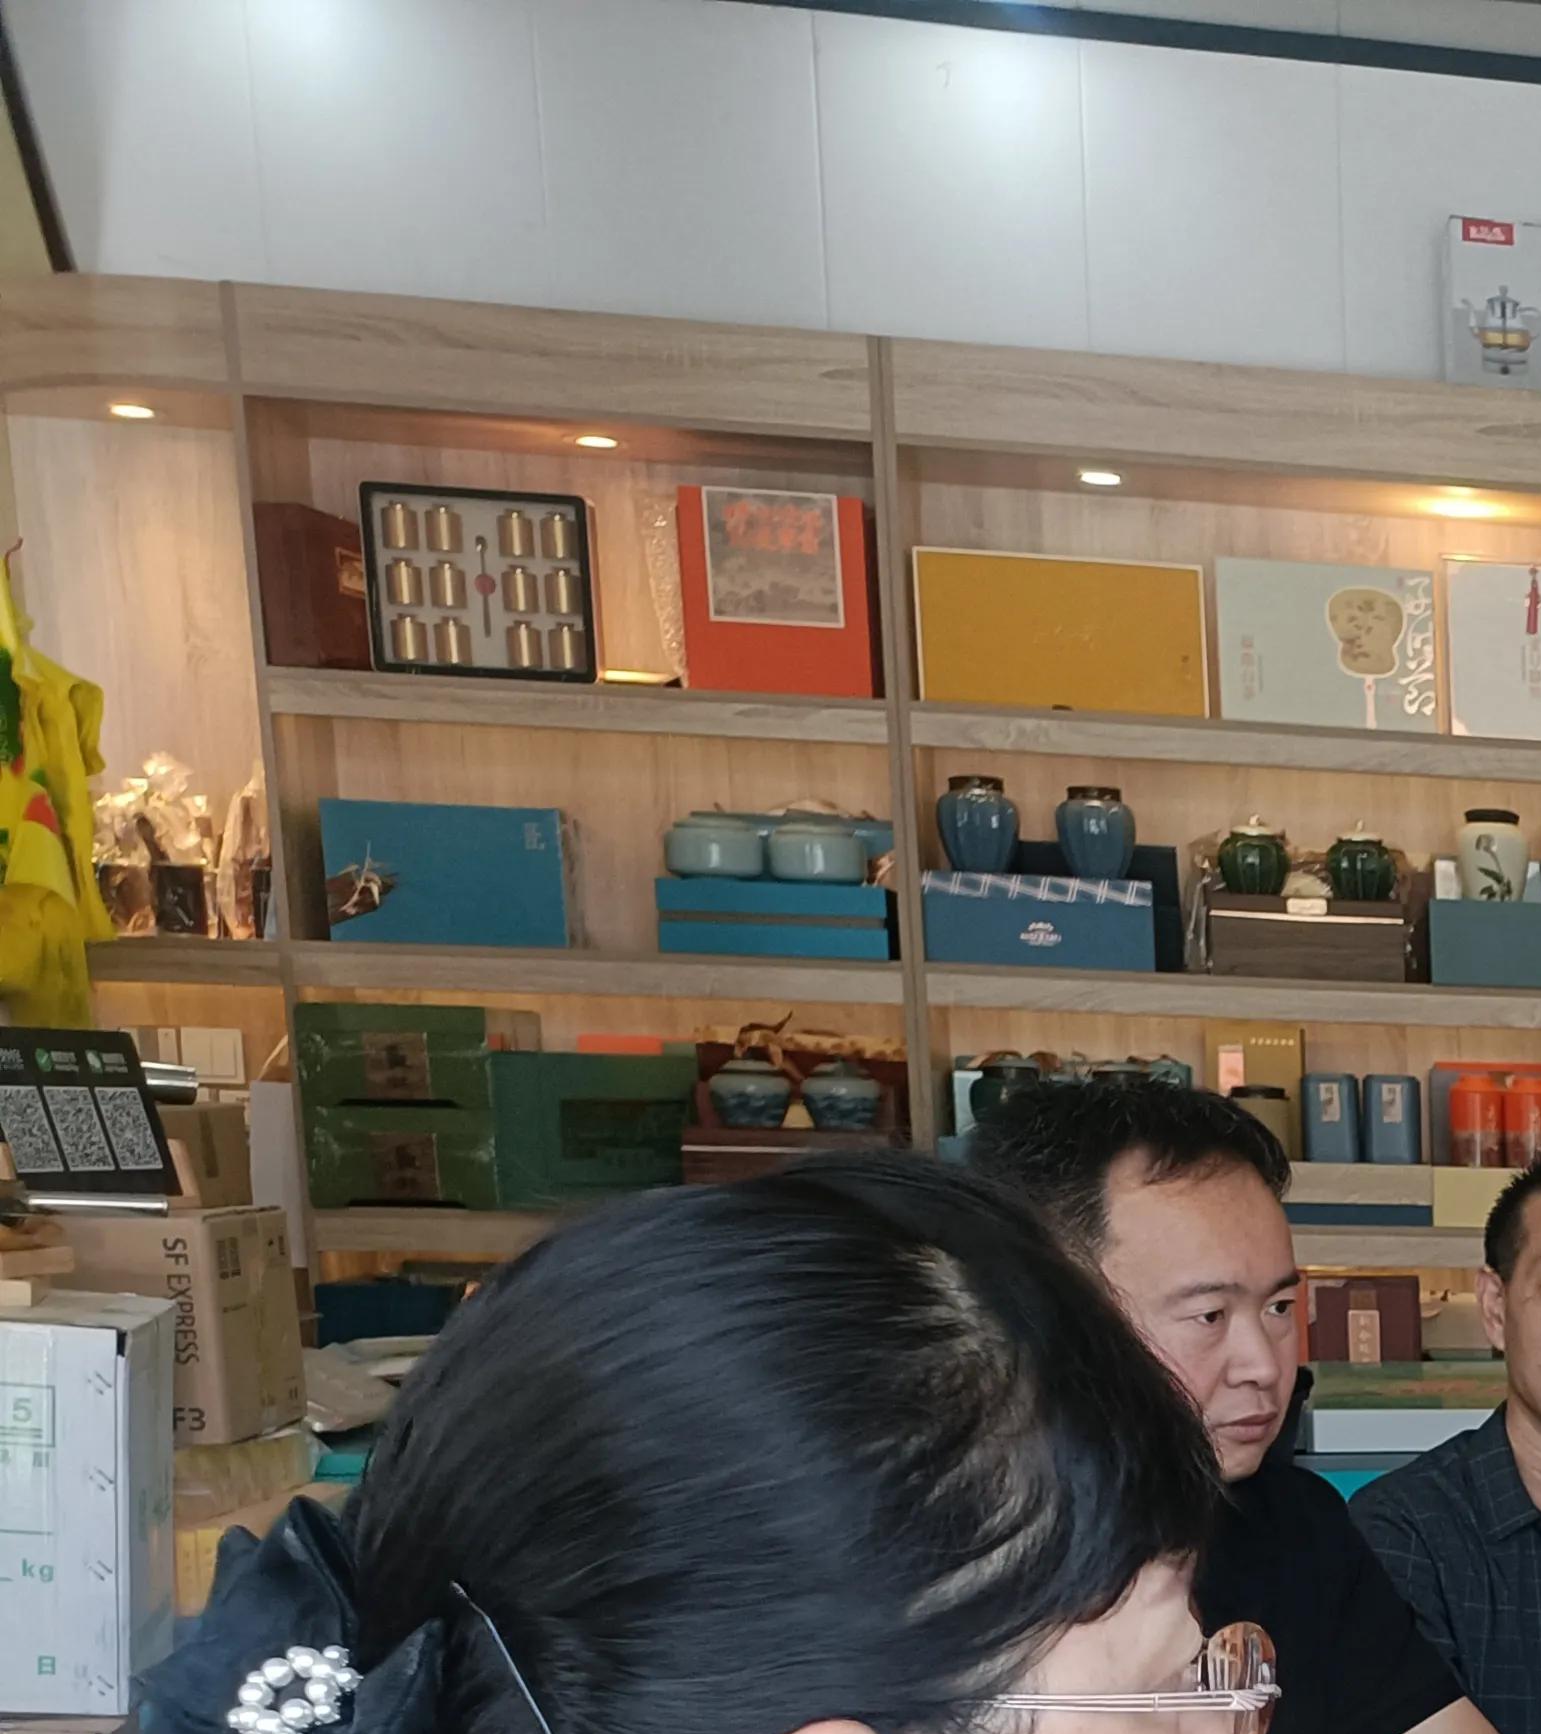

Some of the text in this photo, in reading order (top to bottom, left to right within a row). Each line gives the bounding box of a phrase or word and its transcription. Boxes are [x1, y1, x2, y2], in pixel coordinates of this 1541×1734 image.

[162, 1237, 200, 1366] SF EXPRESS
[21, 1558, 55, 1583] kg
